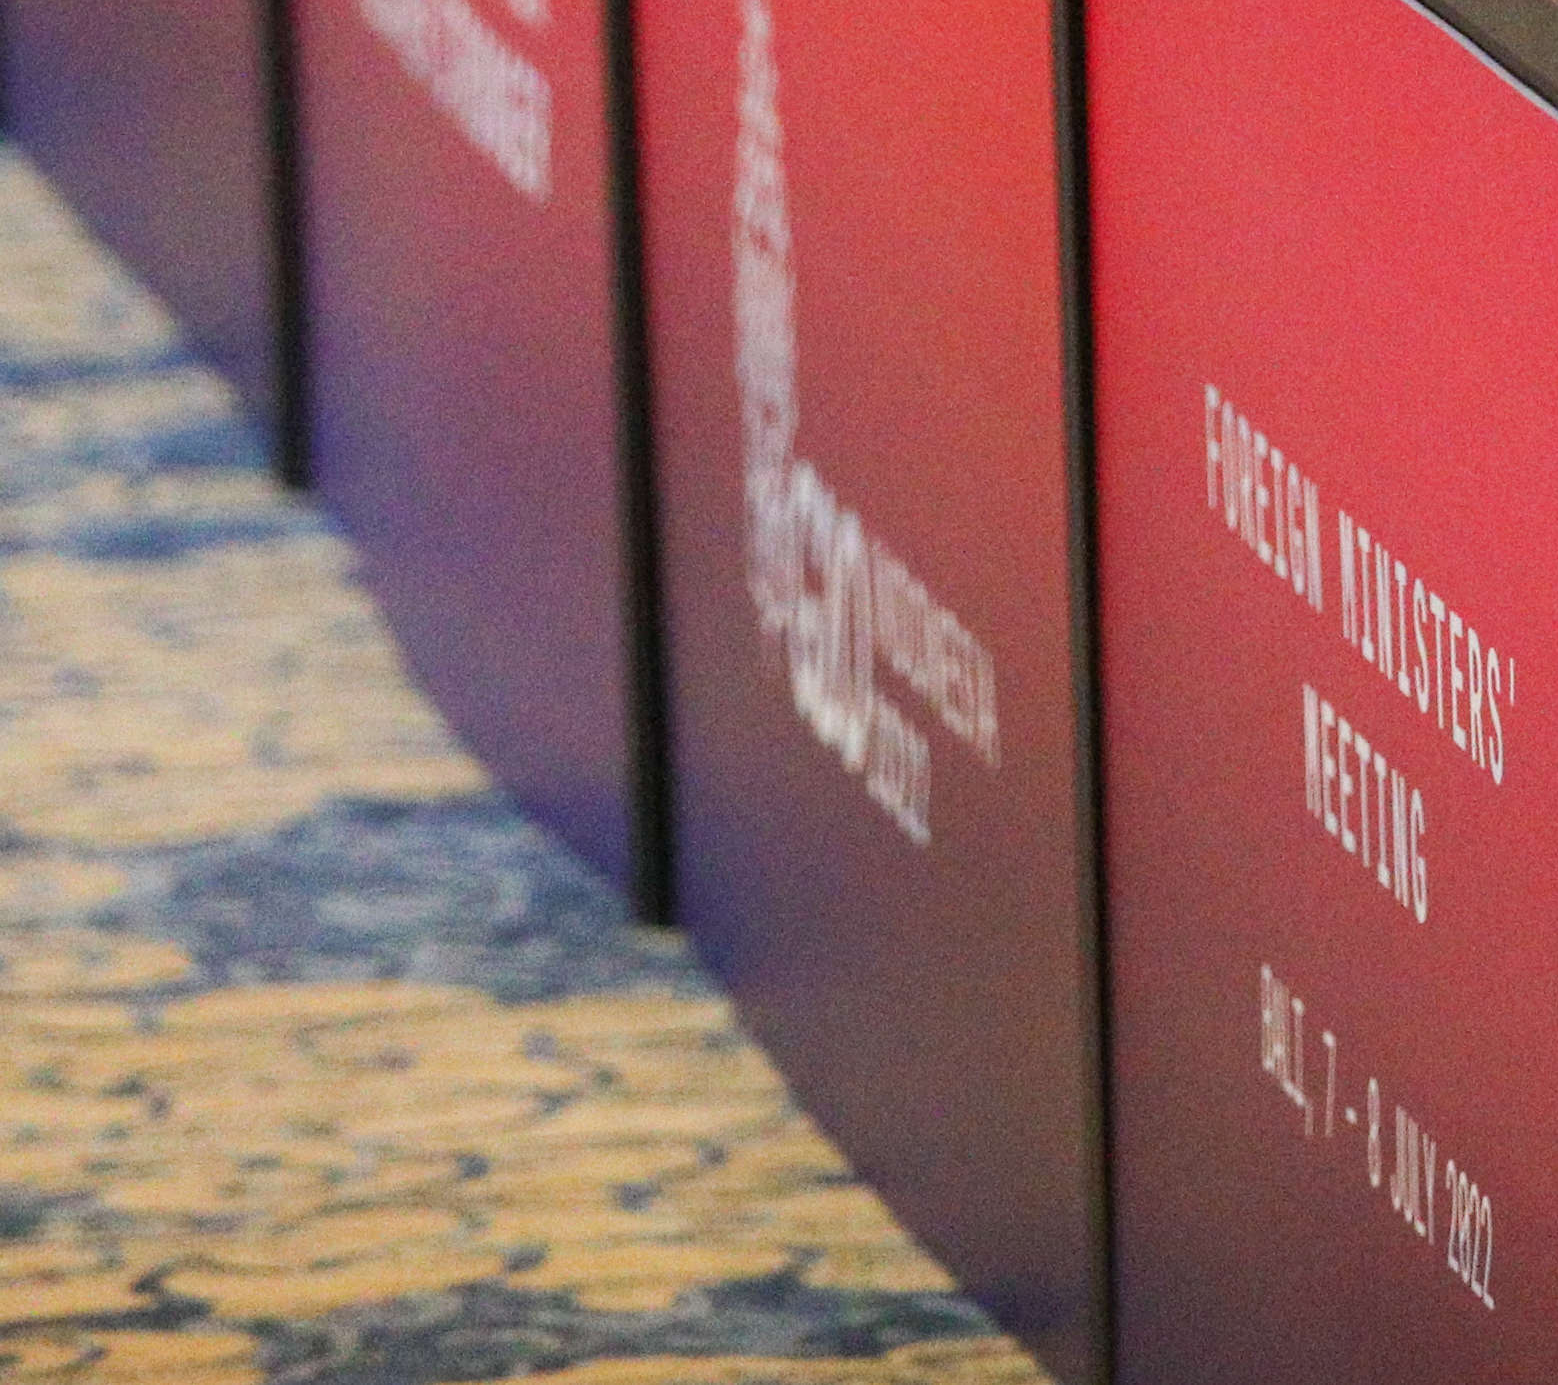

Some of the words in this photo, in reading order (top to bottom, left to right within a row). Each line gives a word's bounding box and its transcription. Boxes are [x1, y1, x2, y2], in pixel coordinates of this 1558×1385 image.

[1204, 382, 1323, 613] FOREIGN
[1302, 682, 1428, 924] MEETING
[1322, 1030, 1337, 1137] 7
[1366, 1076, 1382, 1188] 8
[1390, 1104, 1438, 1246] JULY
[1445, 1157, 1497, 1311] 2022
